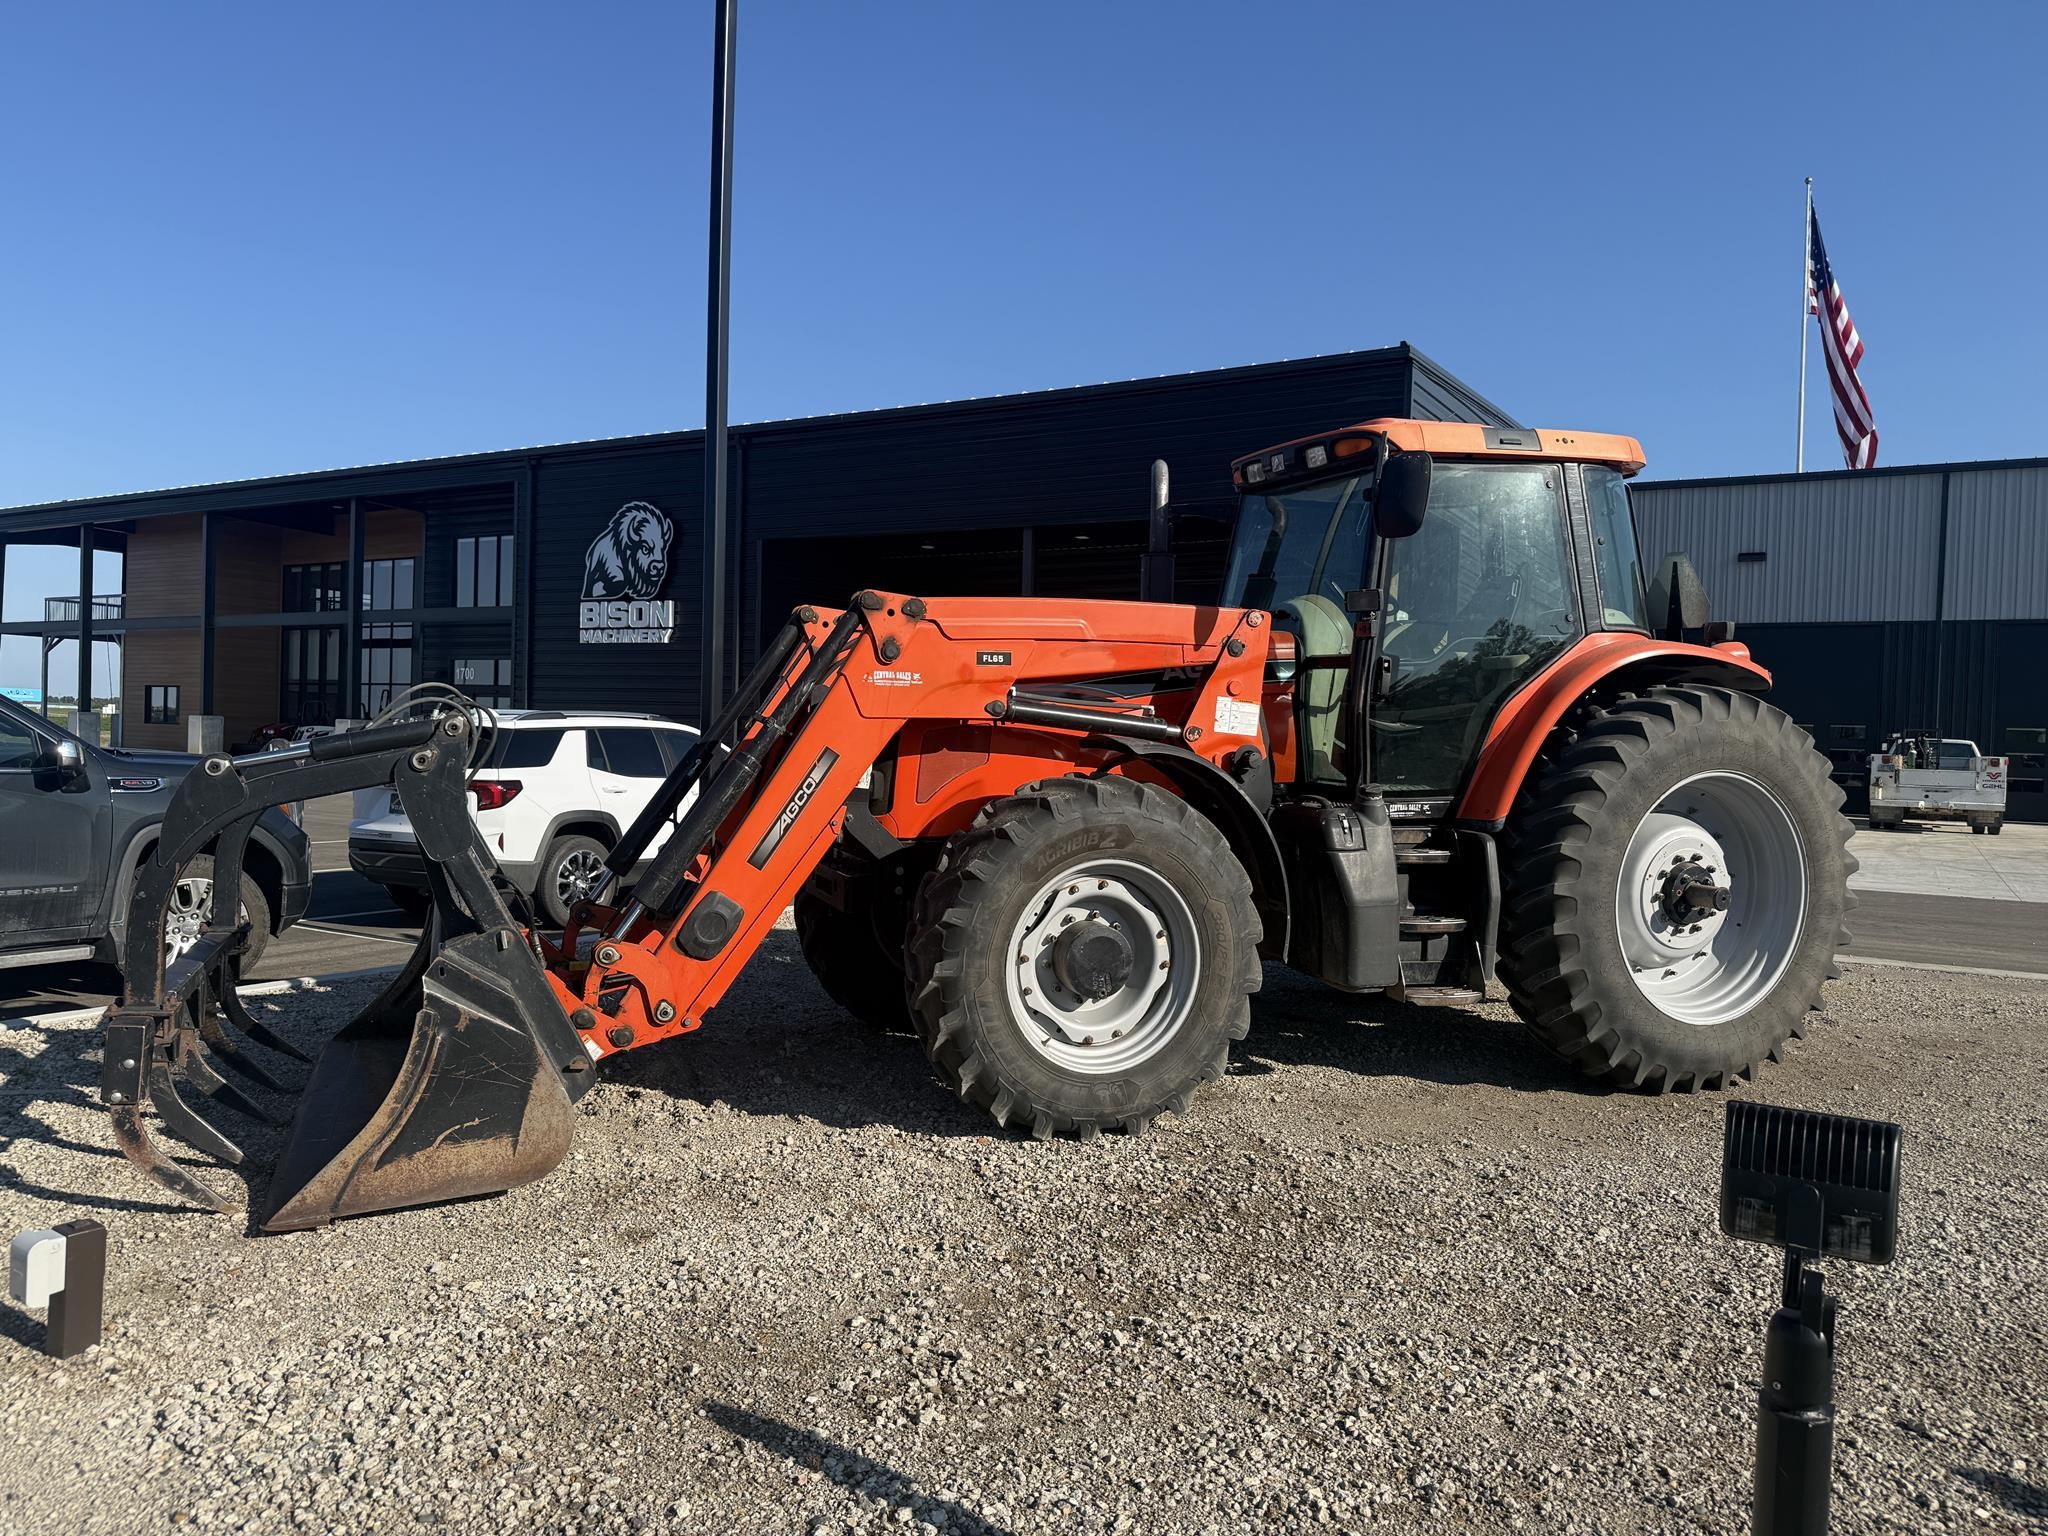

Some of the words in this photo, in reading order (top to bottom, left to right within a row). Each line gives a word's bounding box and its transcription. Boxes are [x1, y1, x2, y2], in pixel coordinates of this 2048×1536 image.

[580, 600, 675, 628] BISON
[580, 629, 673, 643] MACHINERY
[456, 667, 475, 680] 1700
[873, 670, 895, 680] CENTRAL
[896, 671, 912, 680] SALES
[780, 777, 816, 836] AGCO
[1037, 831, 1099, 872] AGRIBIB
[1099, 826, 1120, 849] 2
